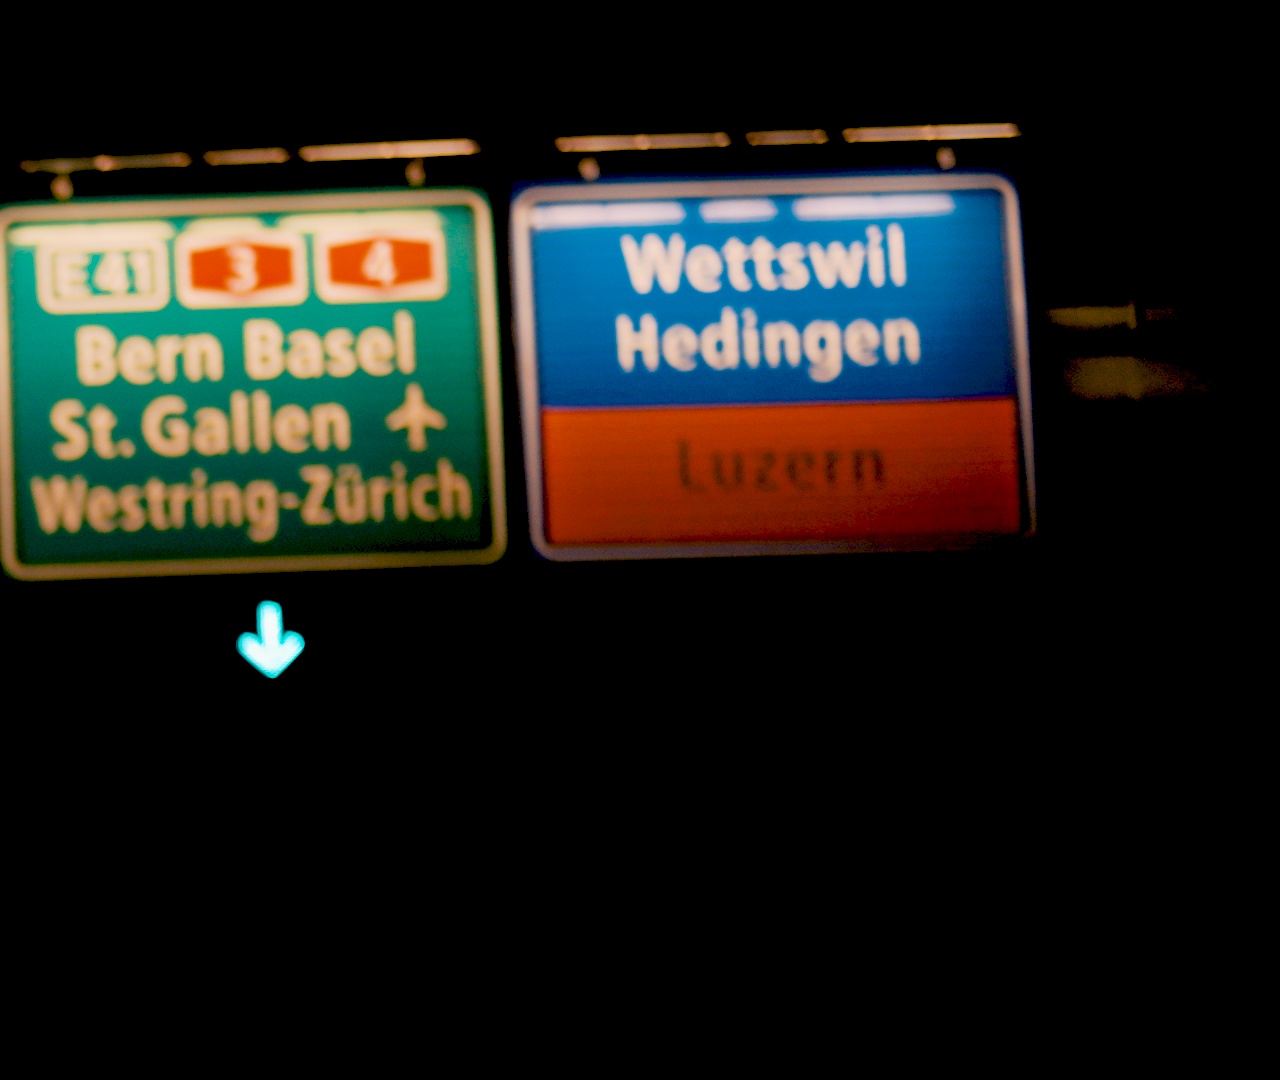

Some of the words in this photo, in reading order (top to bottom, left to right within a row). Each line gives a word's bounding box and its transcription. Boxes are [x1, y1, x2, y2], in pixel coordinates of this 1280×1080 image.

[56, 250, 152, 297] E41
[226, 242, 259, 295] 3
[361, 237, 398, 288] 4
[618, 222, 908, 296] Wettswil
[75, 323, 224, 387] Bern
[243, 308, 416, 381] Basel
[615, 305, 921, 384] Hedingen
[49, 396, 136, 462] St.
[141, 388, 352, 458] Gallen
[31, 456, 473, 544] Westring-Zürich
[676, 438, 887, 491] Luzern
